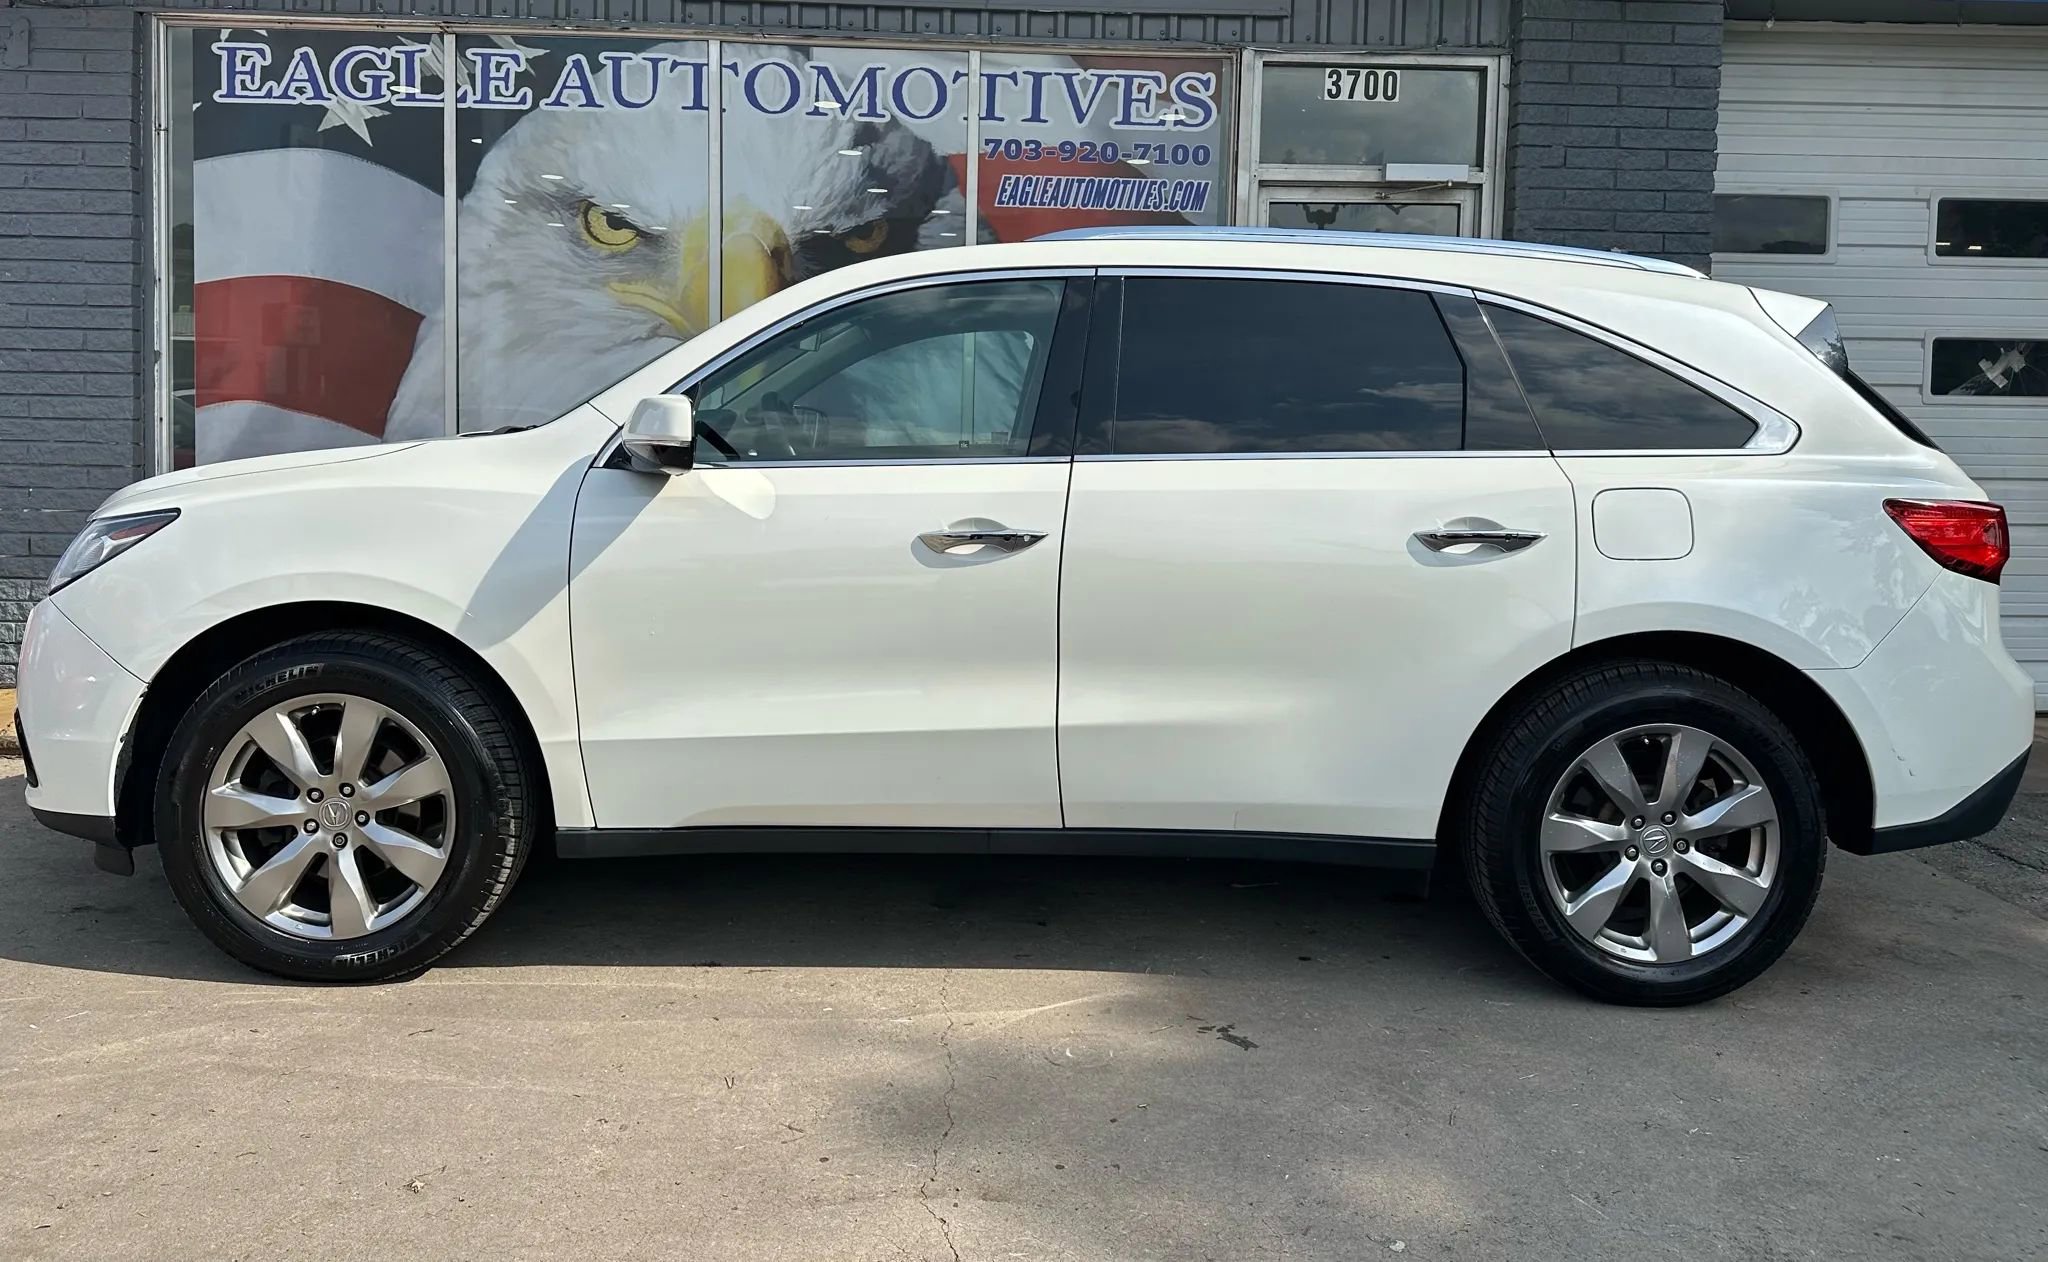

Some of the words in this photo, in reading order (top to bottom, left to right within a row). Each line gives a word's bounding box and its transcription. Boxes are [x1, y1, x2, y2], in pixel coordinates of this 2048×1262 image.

[214, 44, 531, 108] EAGLE
[547, 53, 1217, 129] AUTOMOTIVES
[1326, 69, 1399, 101] 3700
[984, 138, 1211, 166] 703-920-7100
[996, 175, 1211, 212] EAGLEAUTOMOTIVES.COM
[236, 664, 320, 699] MICHELIN
